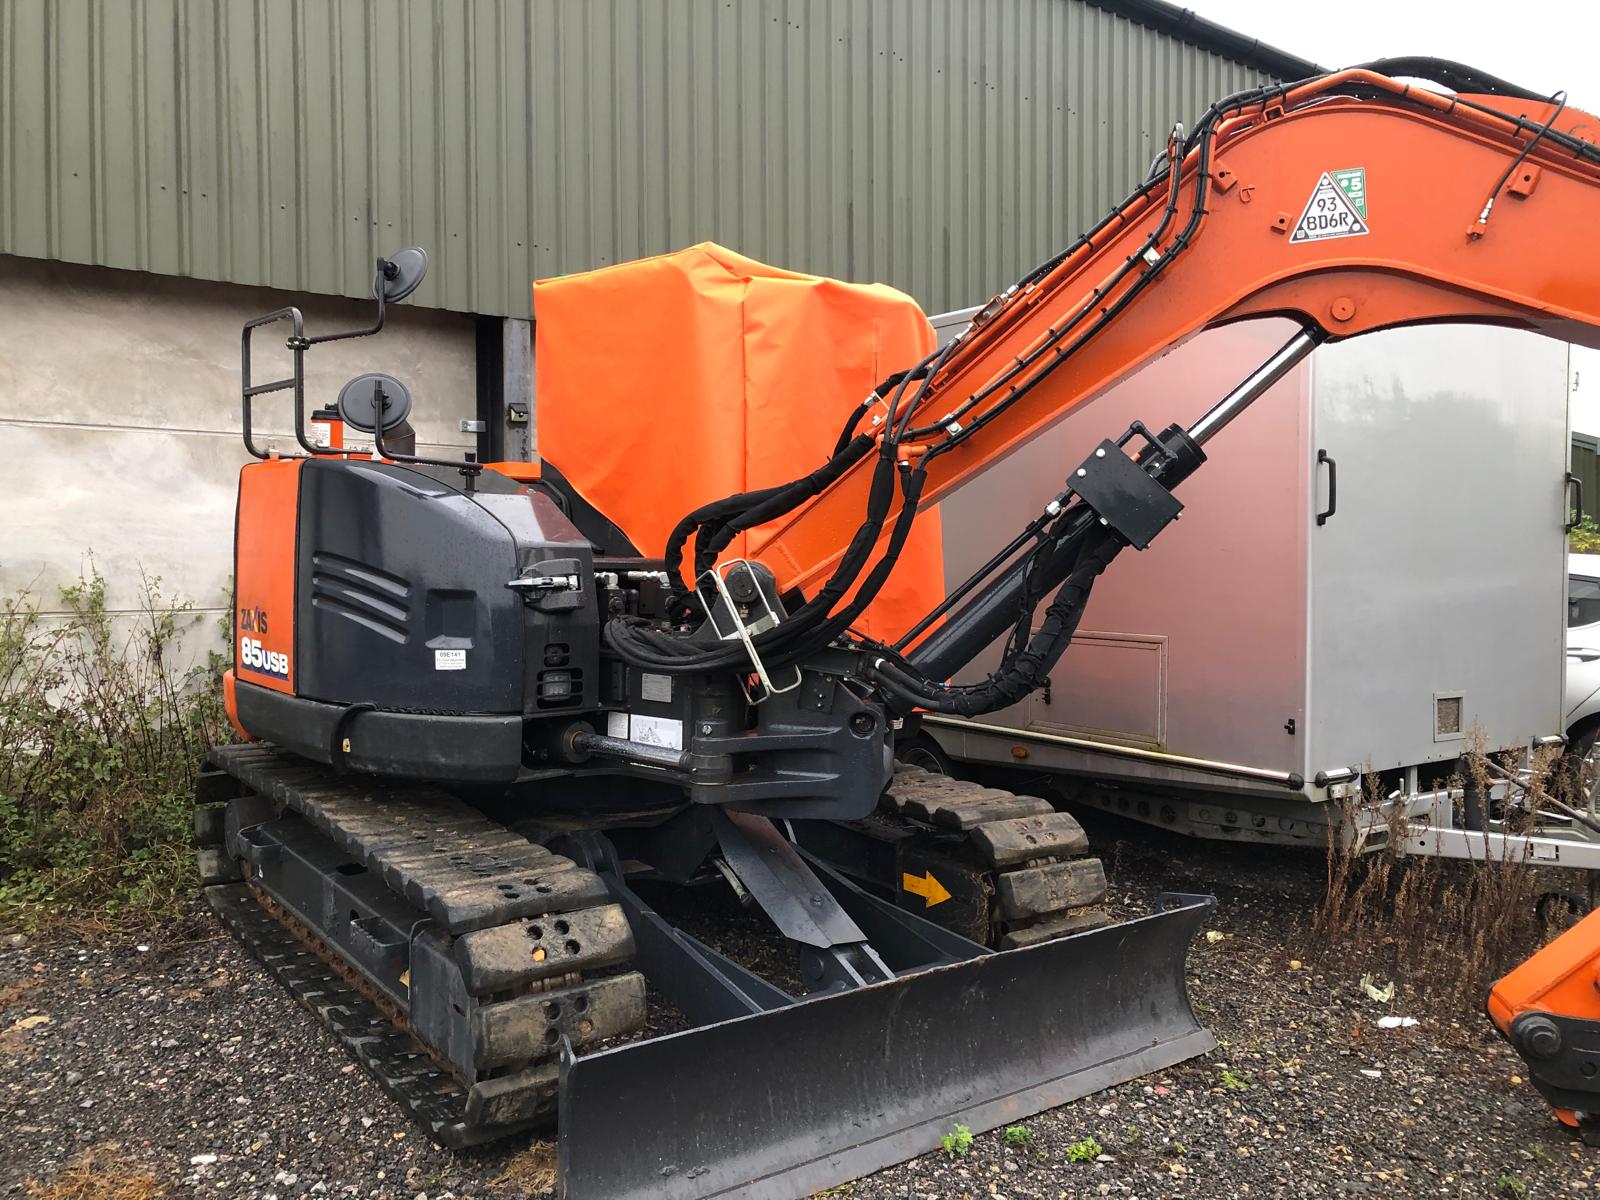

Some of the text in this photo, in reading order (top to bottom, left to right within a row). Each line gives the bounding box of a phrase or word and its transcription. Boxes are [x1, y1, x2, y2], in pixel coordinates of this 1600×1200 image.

[1350, 177, 1362, 191] 5
[1317, 196, 1337, 213] 93
[1306, 211, 1350, 232] BD6R
[241, 605, 268, 635] ZAXIS
[241, 636, 289, 675] 85USB
